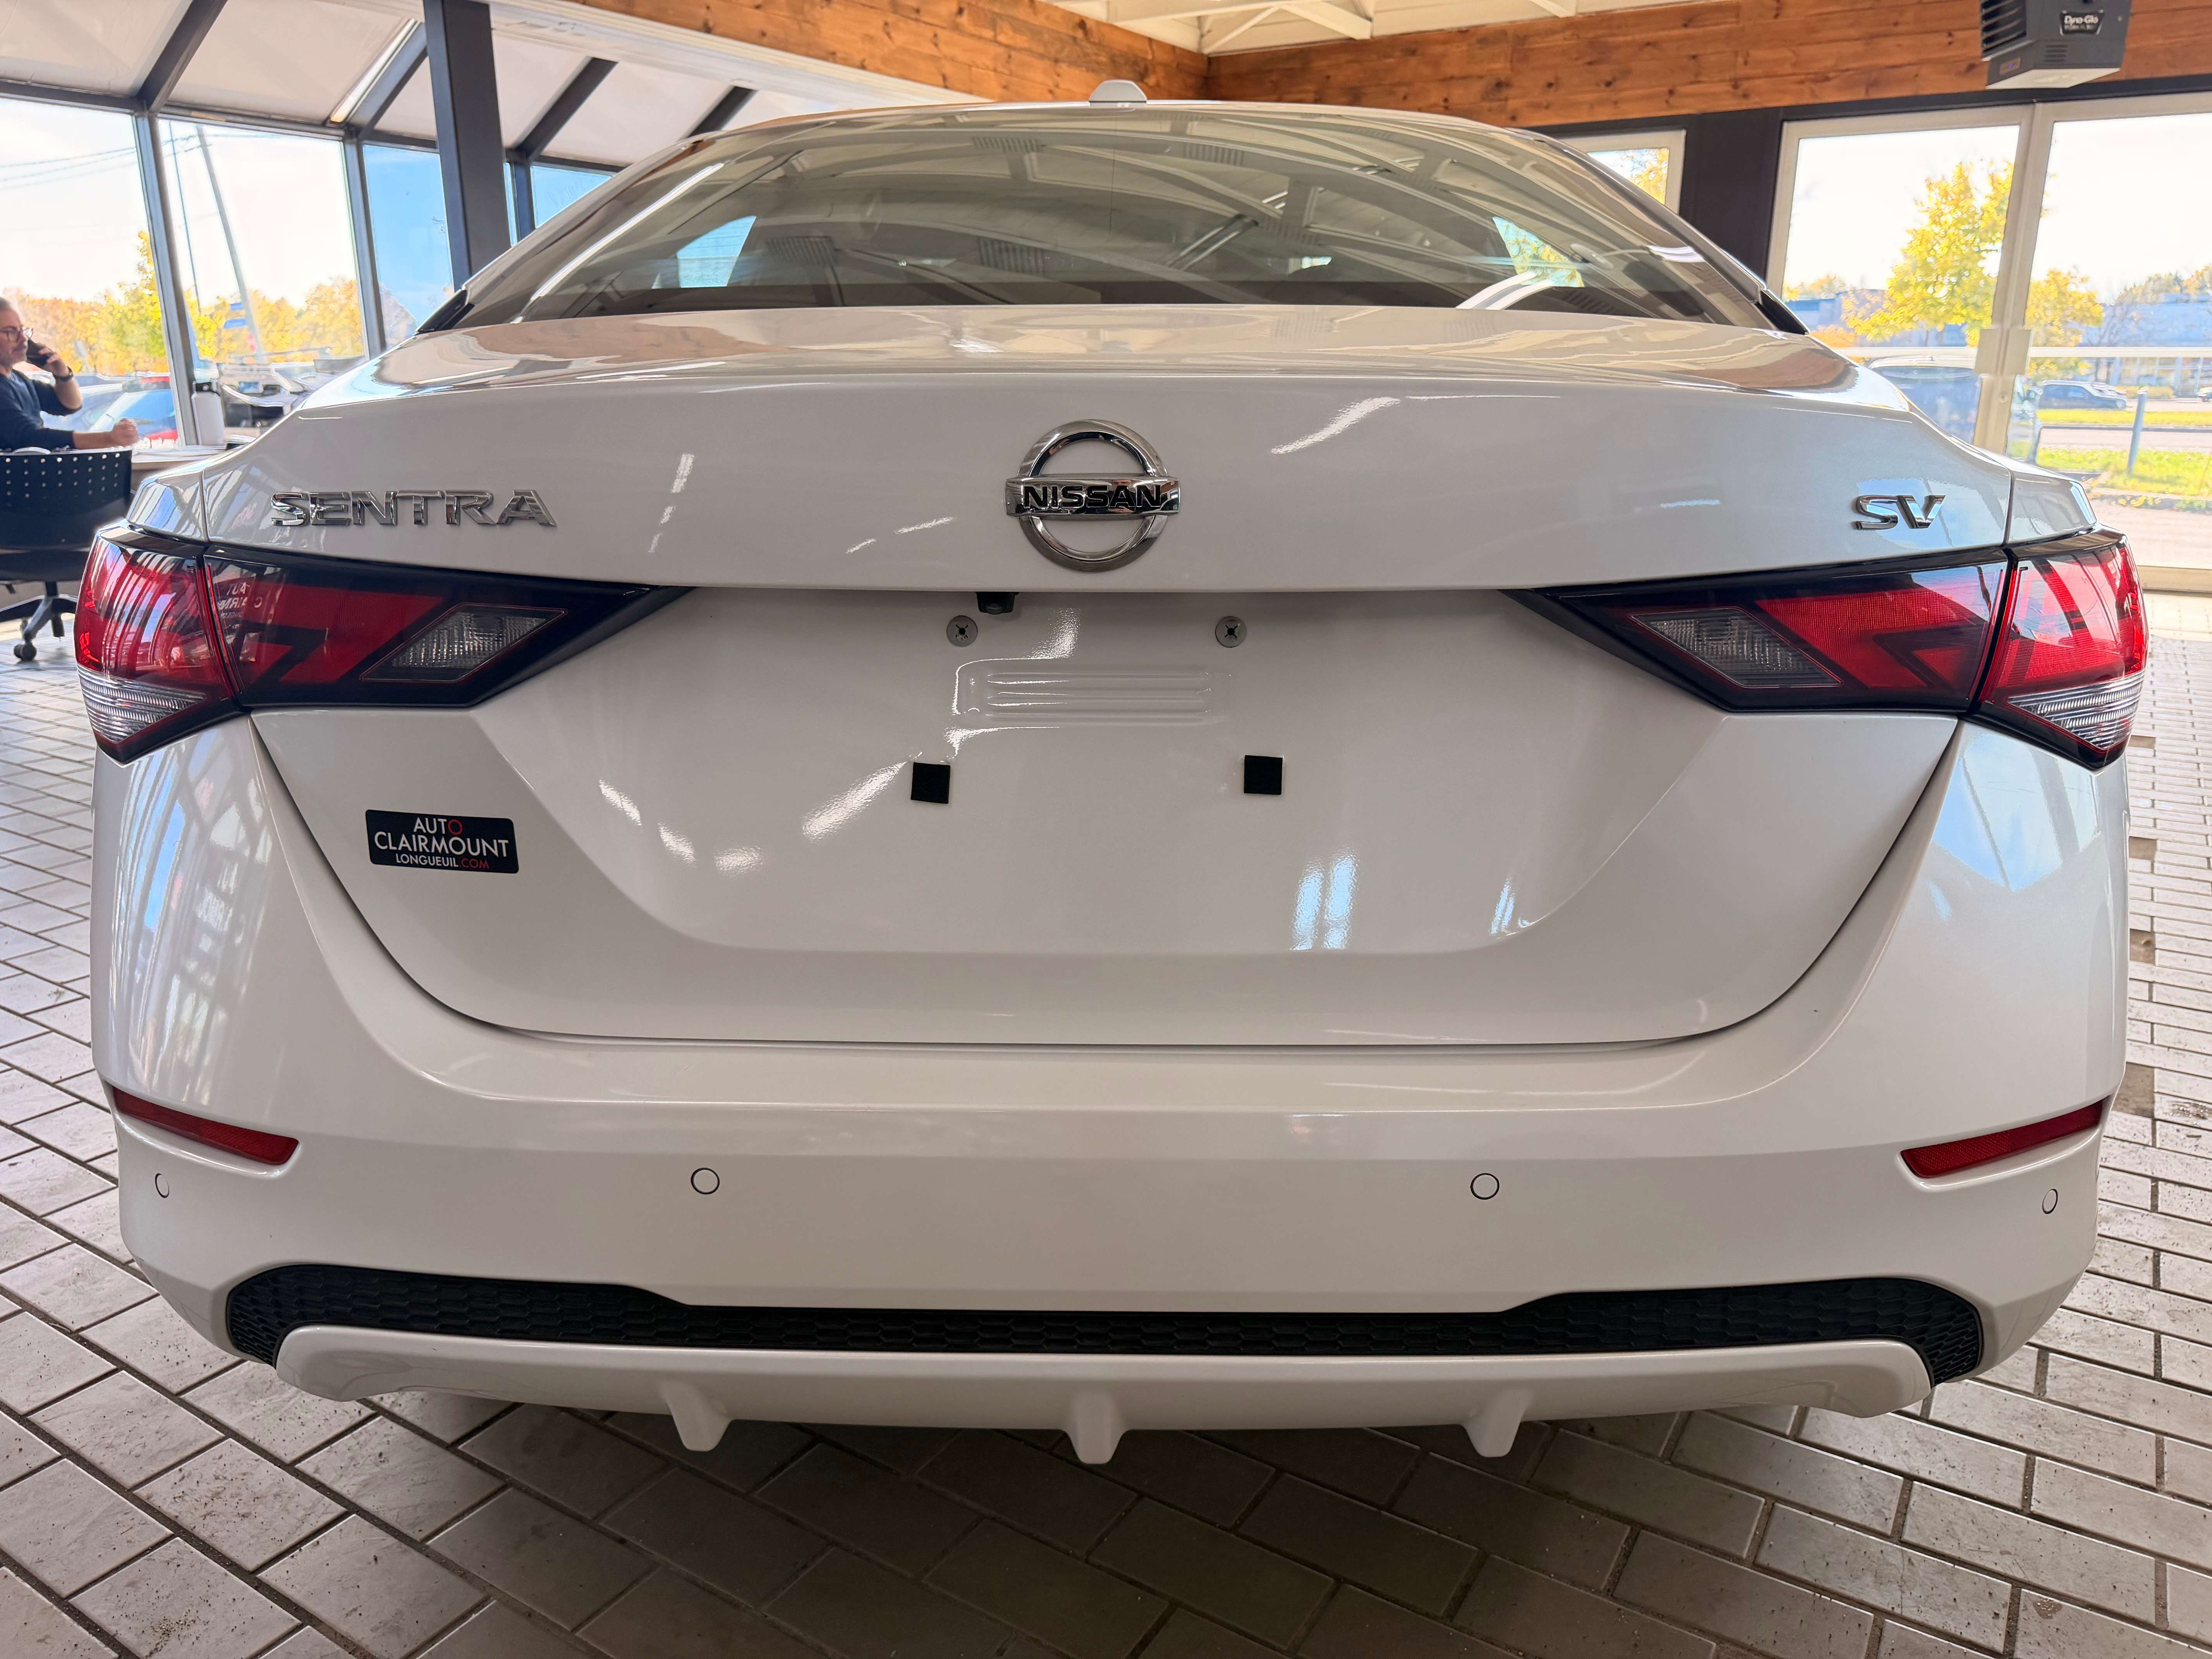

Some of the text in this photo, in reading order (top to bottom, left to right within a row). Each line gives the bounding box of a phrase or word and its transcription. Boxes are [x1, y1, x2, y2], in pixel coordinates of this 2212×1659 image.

[270, 489, 557, 527] SENTRA
[1024, 485, 1162, 509] NISSAN
[1852, 495, 1946, 531] SV
[413, 817, 463, 836] AUTO
[374, 831, 509, 857] CLAIRMOUNT
[395, 853, 489, 869] LONGUEUIL.COM
